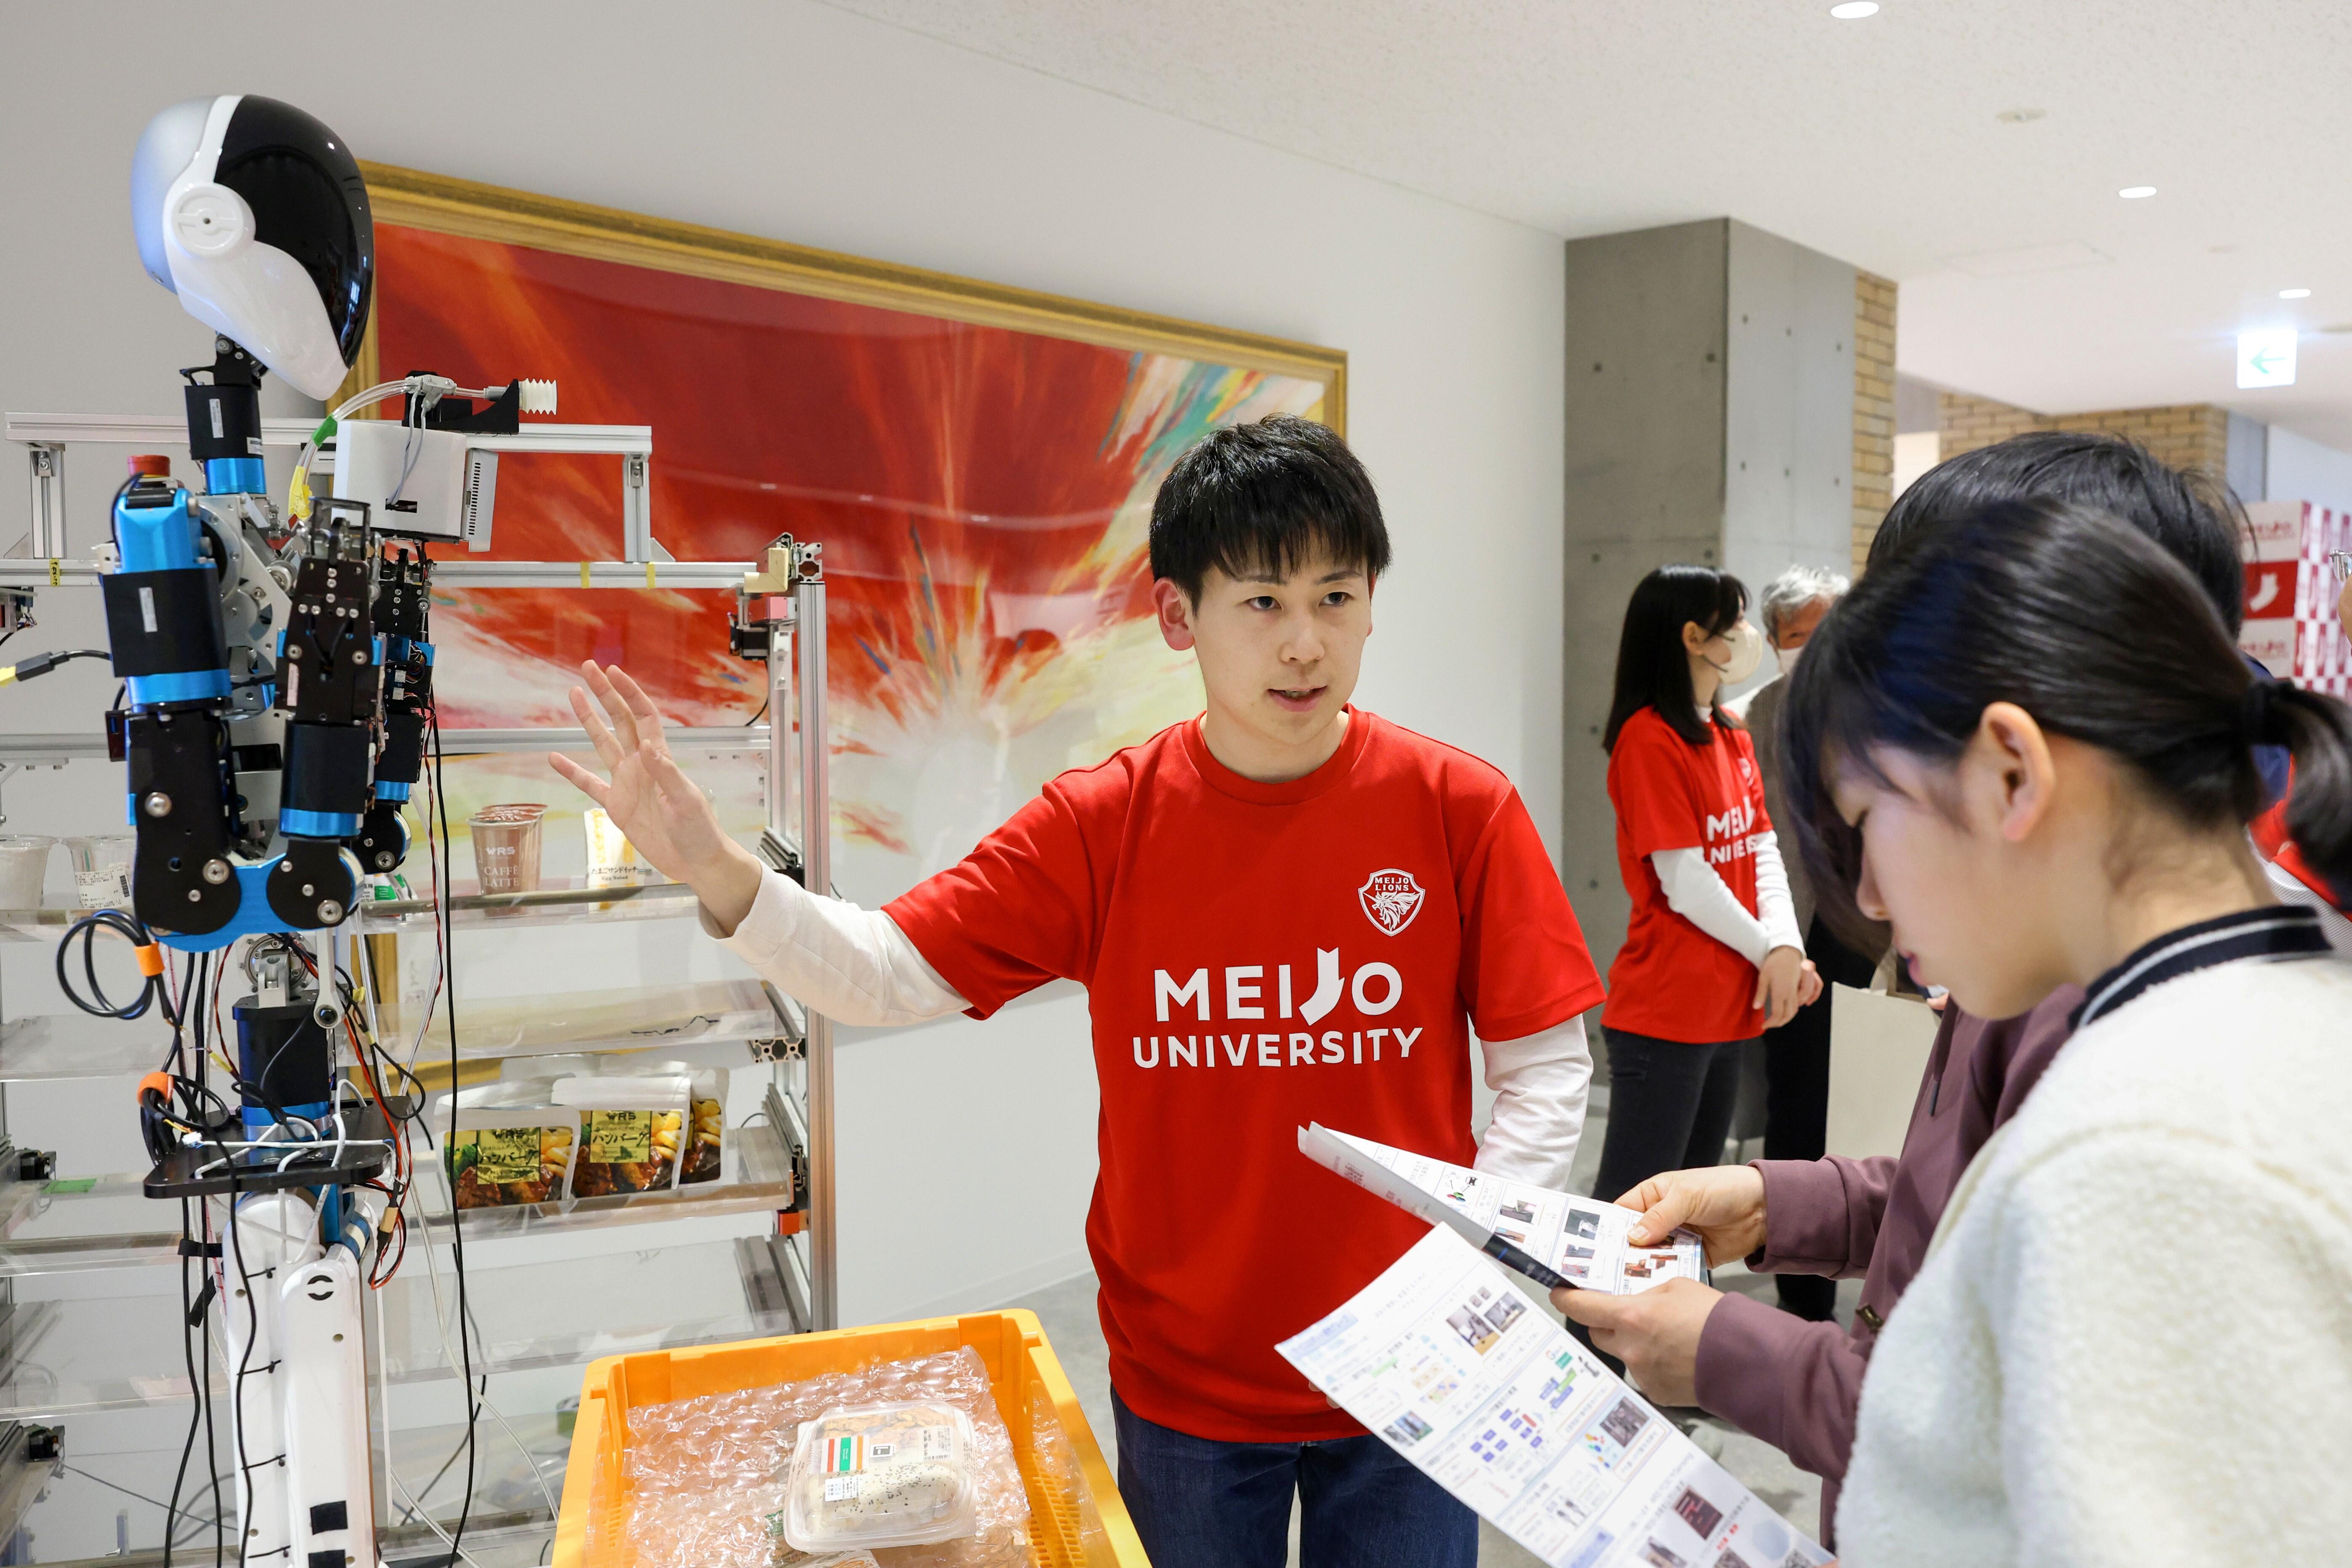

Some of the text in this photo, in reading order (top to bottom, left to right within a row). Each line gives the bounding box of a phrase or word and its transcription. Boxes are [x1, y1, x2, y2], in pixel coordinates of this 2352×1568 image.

[486, 847, 515, 855] WRS
[484, 865, 519, 876] CAFFÈ
[591, 866, 638, 875] たまごサンドイッチ
[484, 878, 519, 887] LATTE
[1155, 947, 1402, 1026] MEIJO
[1133, 1028, 1423, 1068] UNIVERSITY
[606, 1112, 636, 1120] WRS
